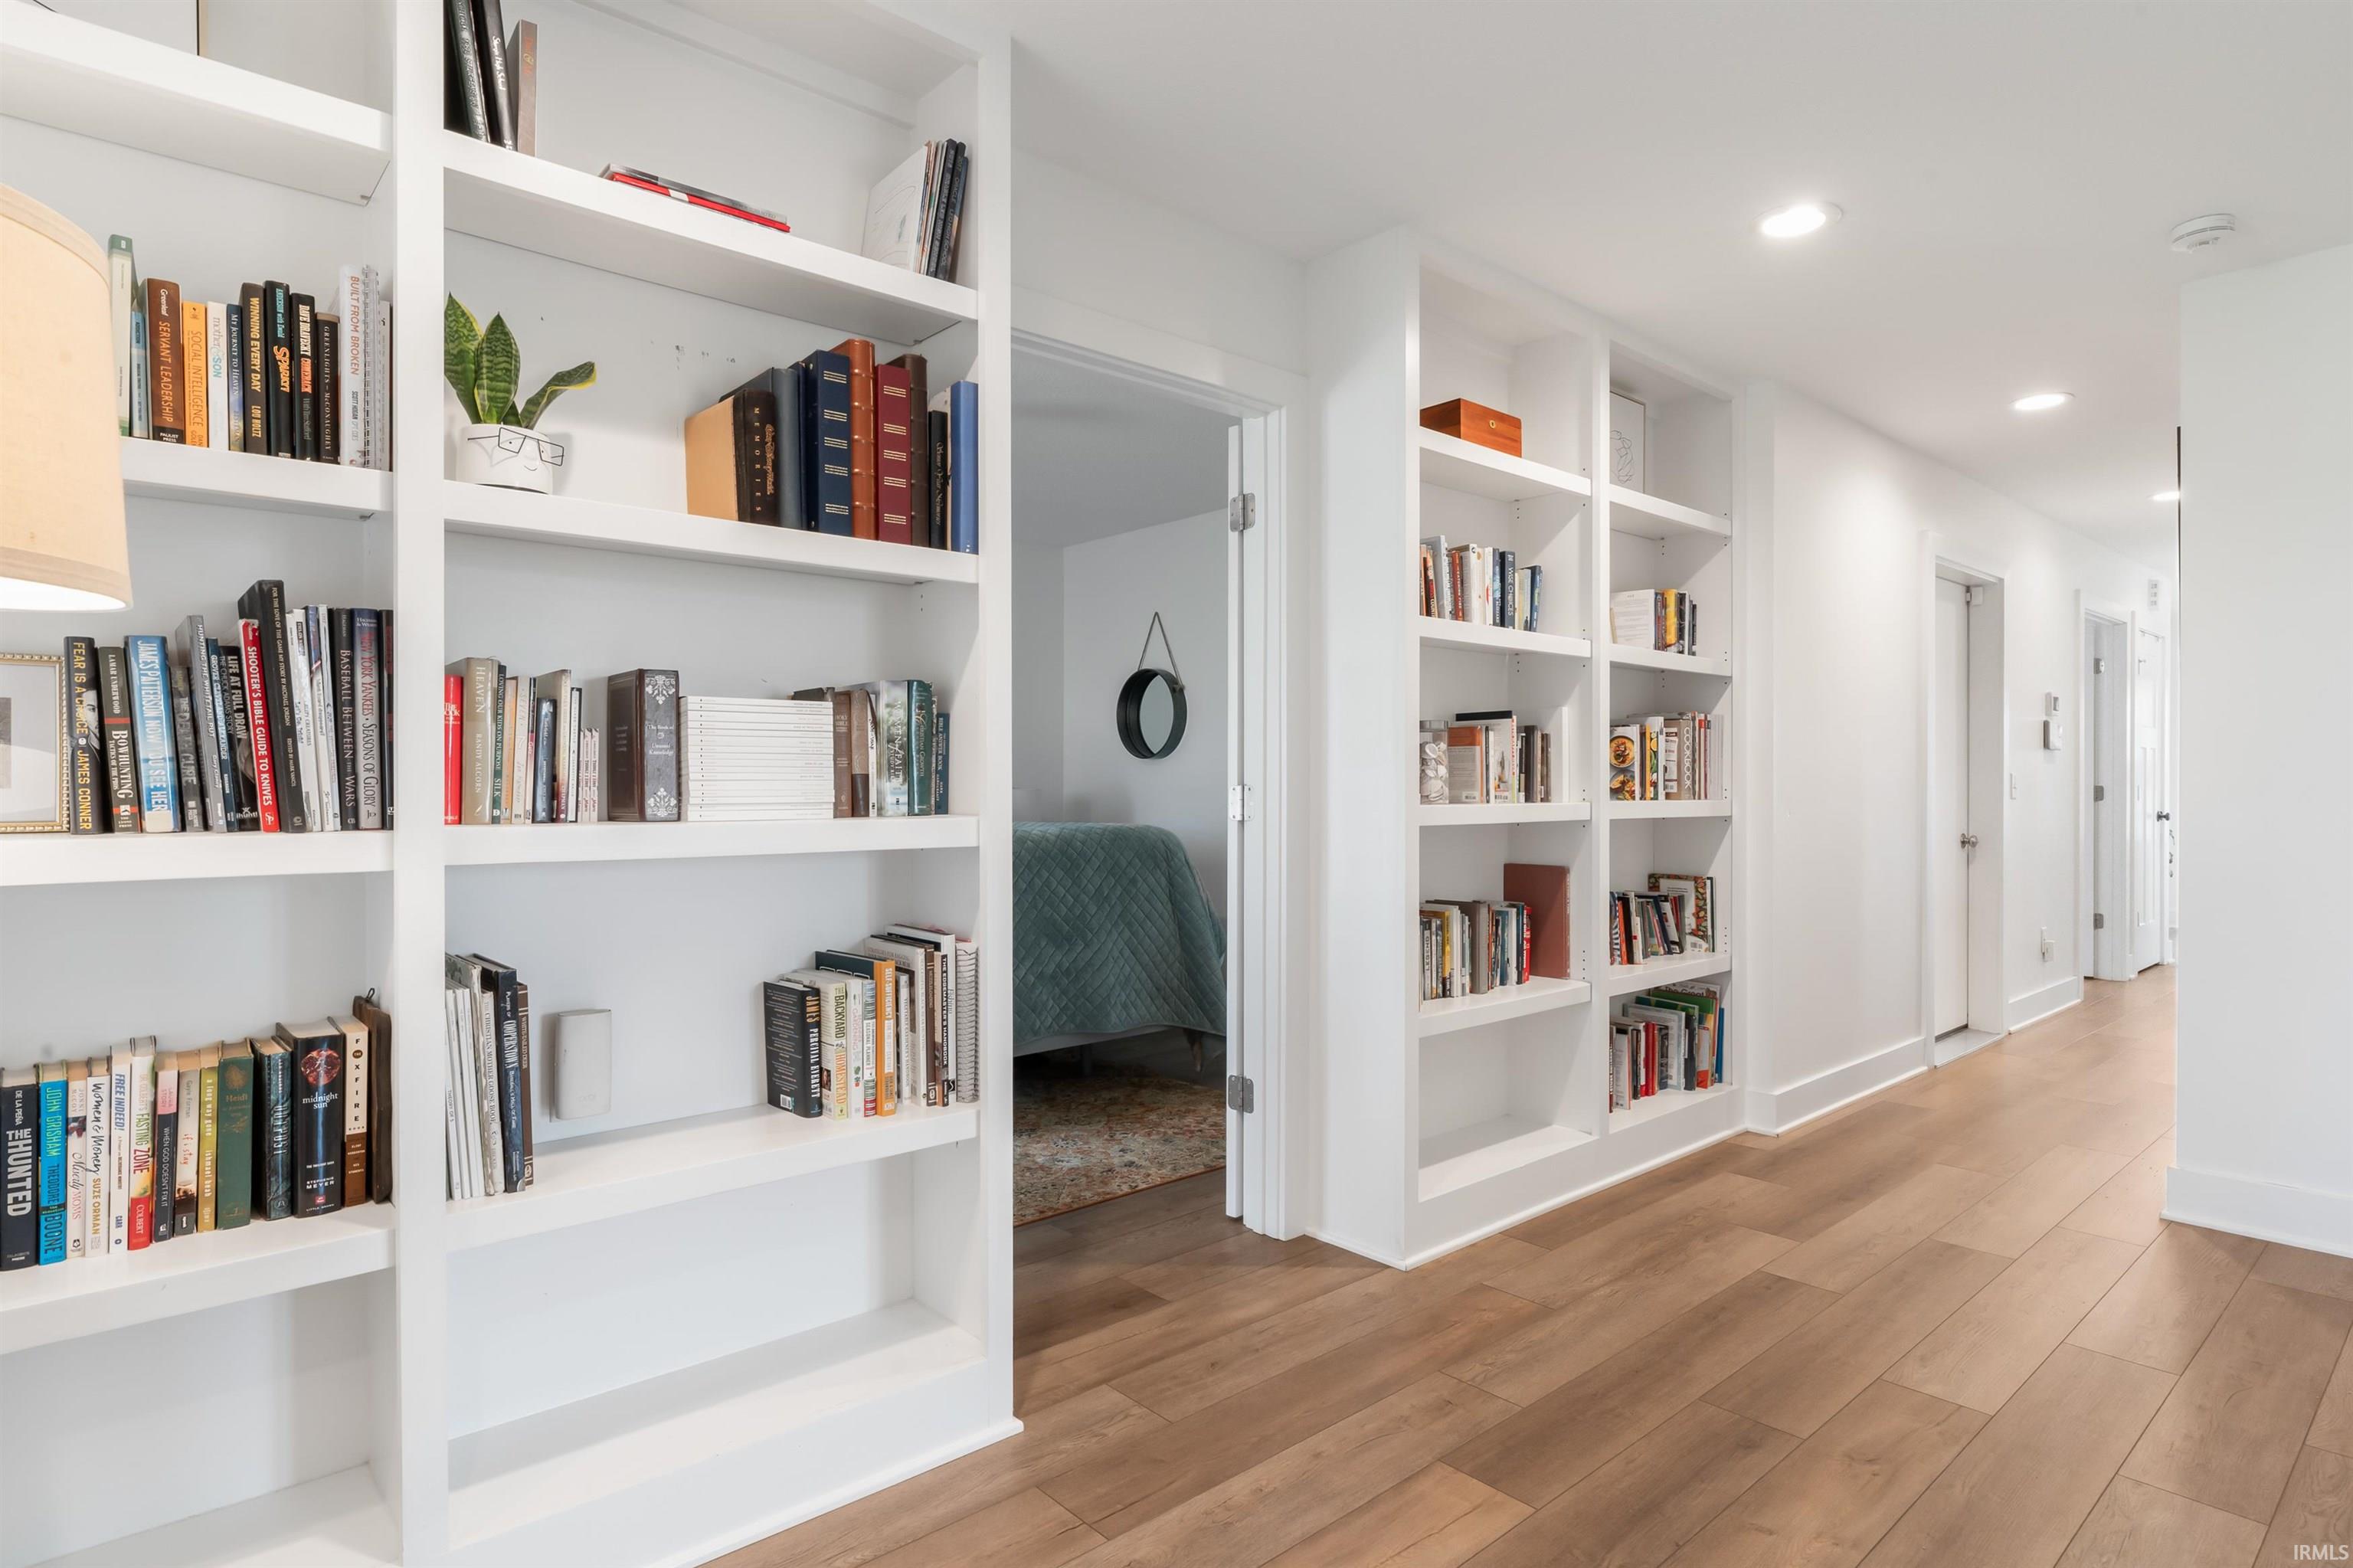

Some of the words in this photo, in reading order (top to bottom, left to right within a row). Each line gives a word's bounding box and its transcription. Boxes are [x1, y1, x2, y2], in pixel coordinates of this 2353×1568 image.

[951, 178, 960, 204] ORACLE
[941, 240, 951, 267] SCHOOL
[159, 288, 169, 317] Greenleaf
[350, 276, 360, 303] BUILT
[250, 297, 260, 338] WINNING
[299, 304, 310, 322] DAVE
[351, 304, 360, 332] FROM
[159, 321, 172, 362] SERVANT
[191, 331, 203, 362] SOCIAL
[250, 340, 261, 371] EVERY
[351, 336, 361, 376] BROKEN
[159, 365, 173, 423] LEADERSHIP
[191, 365, 204, 427] INTELLIGENCE
[251, 373, 262, 393] DAY
[252, 406, 261, 418] LOU
[252, 419, 261, 438] HOLTZ
[74, 642, 86, 668] FEAR
[138, 640, 160, 669] JAMES
[361, 633, 375, 653] NEW
[75, 673, 86, 683] IS
[109, 654, 117, 675] LAMAR
[227, 655, 238, 674] LIFE
[247, 646, 263, 698] SHOOTER'S
[340, 649, 352, 701] BASEBALL
[361, 655, 376, 679] YORK
[110, 676, 121, 714] UNDERWOOD
[139, 671, 162, 717] PATTERSON
[231, 676, 241, 688] AT
[475, 666, 486, 713] HEAVEN
[231, 689, 242, 710] FULL
[254, 700, 266, 725] BIBLE
[361, 680, 377, 716] YANKEES
[76, 696, 87, 735] CHOICE
[234, 712, 247, 739] DRAW
[145, 721, 162, 743] NOW
[256, 726, 268, 757] GUIDE
[342, 707, 354, 758] BETWEEN
[362, 722, 378, 761] SEASONS
[77, 750, 90, 784] JAMES
[113, 729, 133, 799] BOWHUNTING
[146, 746, 164, 766] YOU
[259, 758, 269, 771] TO
[363, 763, 376, 774] OF
[1684, 727, 1692, 789] COOKBOOK
[149, 769, 166, 787] SEE
[260, 773, 273, 806] KNIVES
[345, 775, 356, 807] WARS
[362, 776, 378, 807] GLORY
[79, 788, 92, 830] CONNER
[151, 791, 169, 812] HER
[502, 991, 512, 1010] PLAYERS
[806, 995, 820, 1023] JAMES
[834, 995, 846, 1039] BACKYARD
[503, 1020, 519, 1069] COOPERSTOWN
[809, 1027, 820, 1063] PERCIVAL
[114, 1073, 126, 1097] FREE
[810, 1065, 820, 1097] EVERETT
[835, 1053, 846, 1104] HOMESTEAD
[15, 1090, 23, 1098] DE
[15, 1098, 22, 1108] LA
[46, 1086, 61, 1111] JOHN
[92, 1083, 105, 1123] Women
[225, 1093, 248, 1102] Heidi
[302, 1092, 338, 1105] midnight
[15, 1108, 23, 1124] PEÑA
[96, 1124, 104, 1134] &
[114, 1098, 126, 1131] INDEED!
[6, 1128, 32, 1139] THE
[46, 1115, 61, 1156] GRISHAM
[135, 1113, 150, 1146] FASTING
[273, 1105, 290, 1155] OUTPOST
[86, 1135, 103, 1175] Money
[133, 1147, 150, 1174] ZONE
[205, 1151, 214, 1177] ishmael
[6, 1138, 32, 1216] HUNTED
[47, 1164, 61, 1204] THEODORE
[68, 1152, 86, 1190] Miserly
[306, 1180, 335, 1189] MEYER
[92, 1178, 101, 1200] SUZE
[204, 1180, 214, 1196] beah
[72, 1191, 80, 1220] MOMS
[92, 1201, 101, 1235] ORMAN
[136, 1204, 144, 1234] COLBERT
[44, 1213, 64, 1254] BOONE
